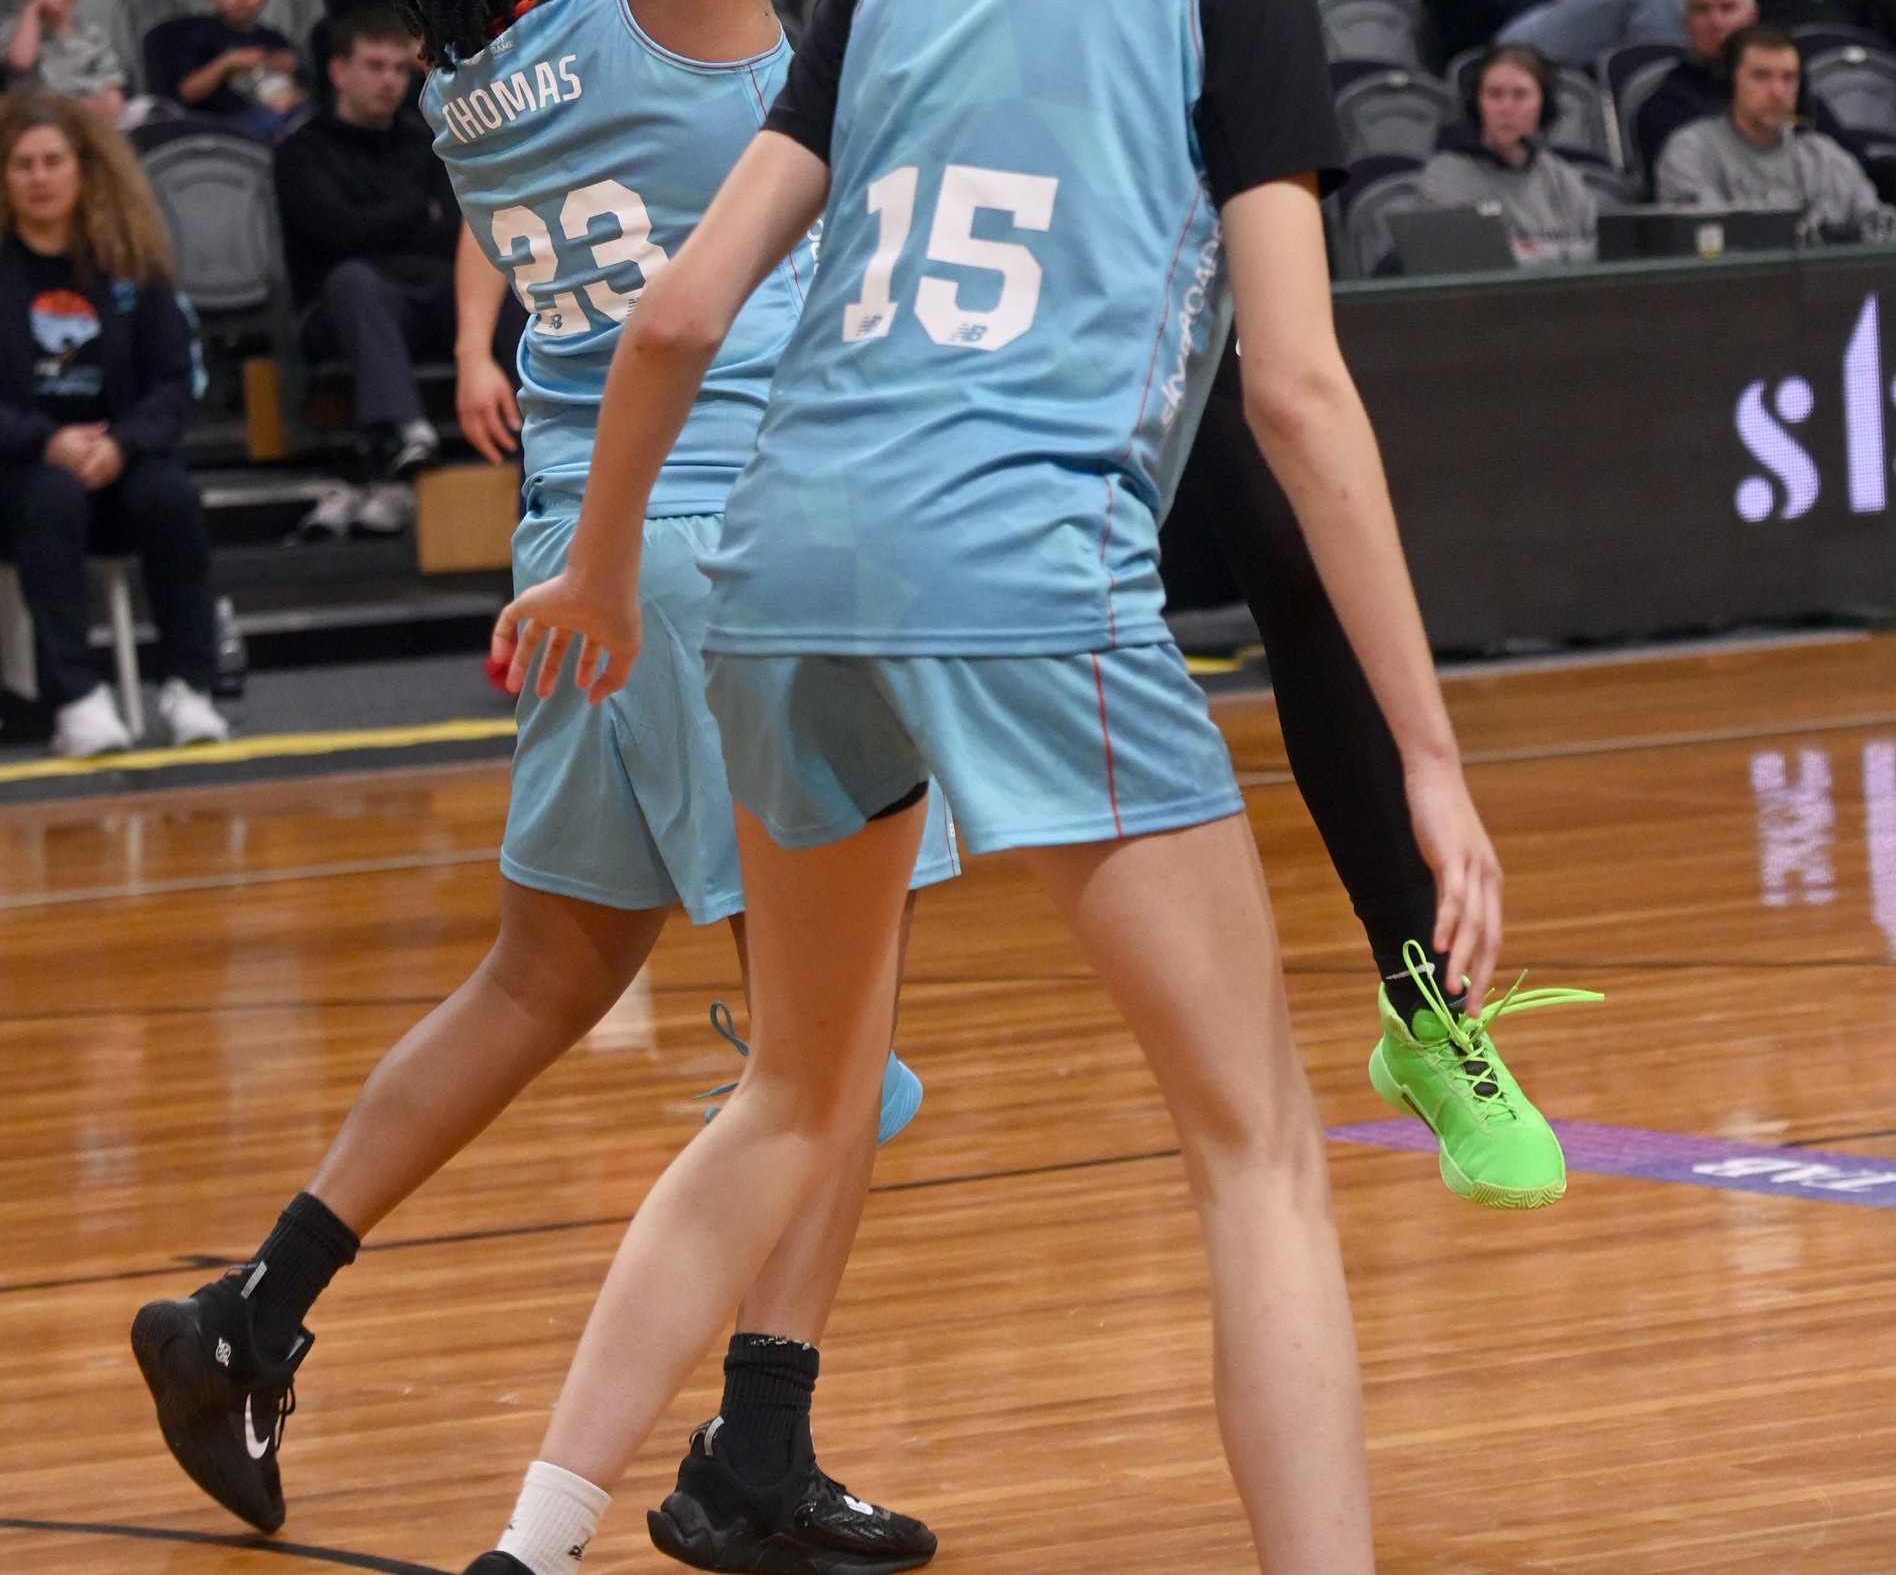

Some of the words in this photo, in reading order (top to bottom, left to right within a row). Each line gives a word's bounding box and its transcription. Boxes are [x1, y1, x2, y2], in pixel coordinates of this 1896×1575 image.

[441, 53, 583, 144] THOMAS
[491, 178, 670, 337] 23
[842, 163, 1060, 352] 15
